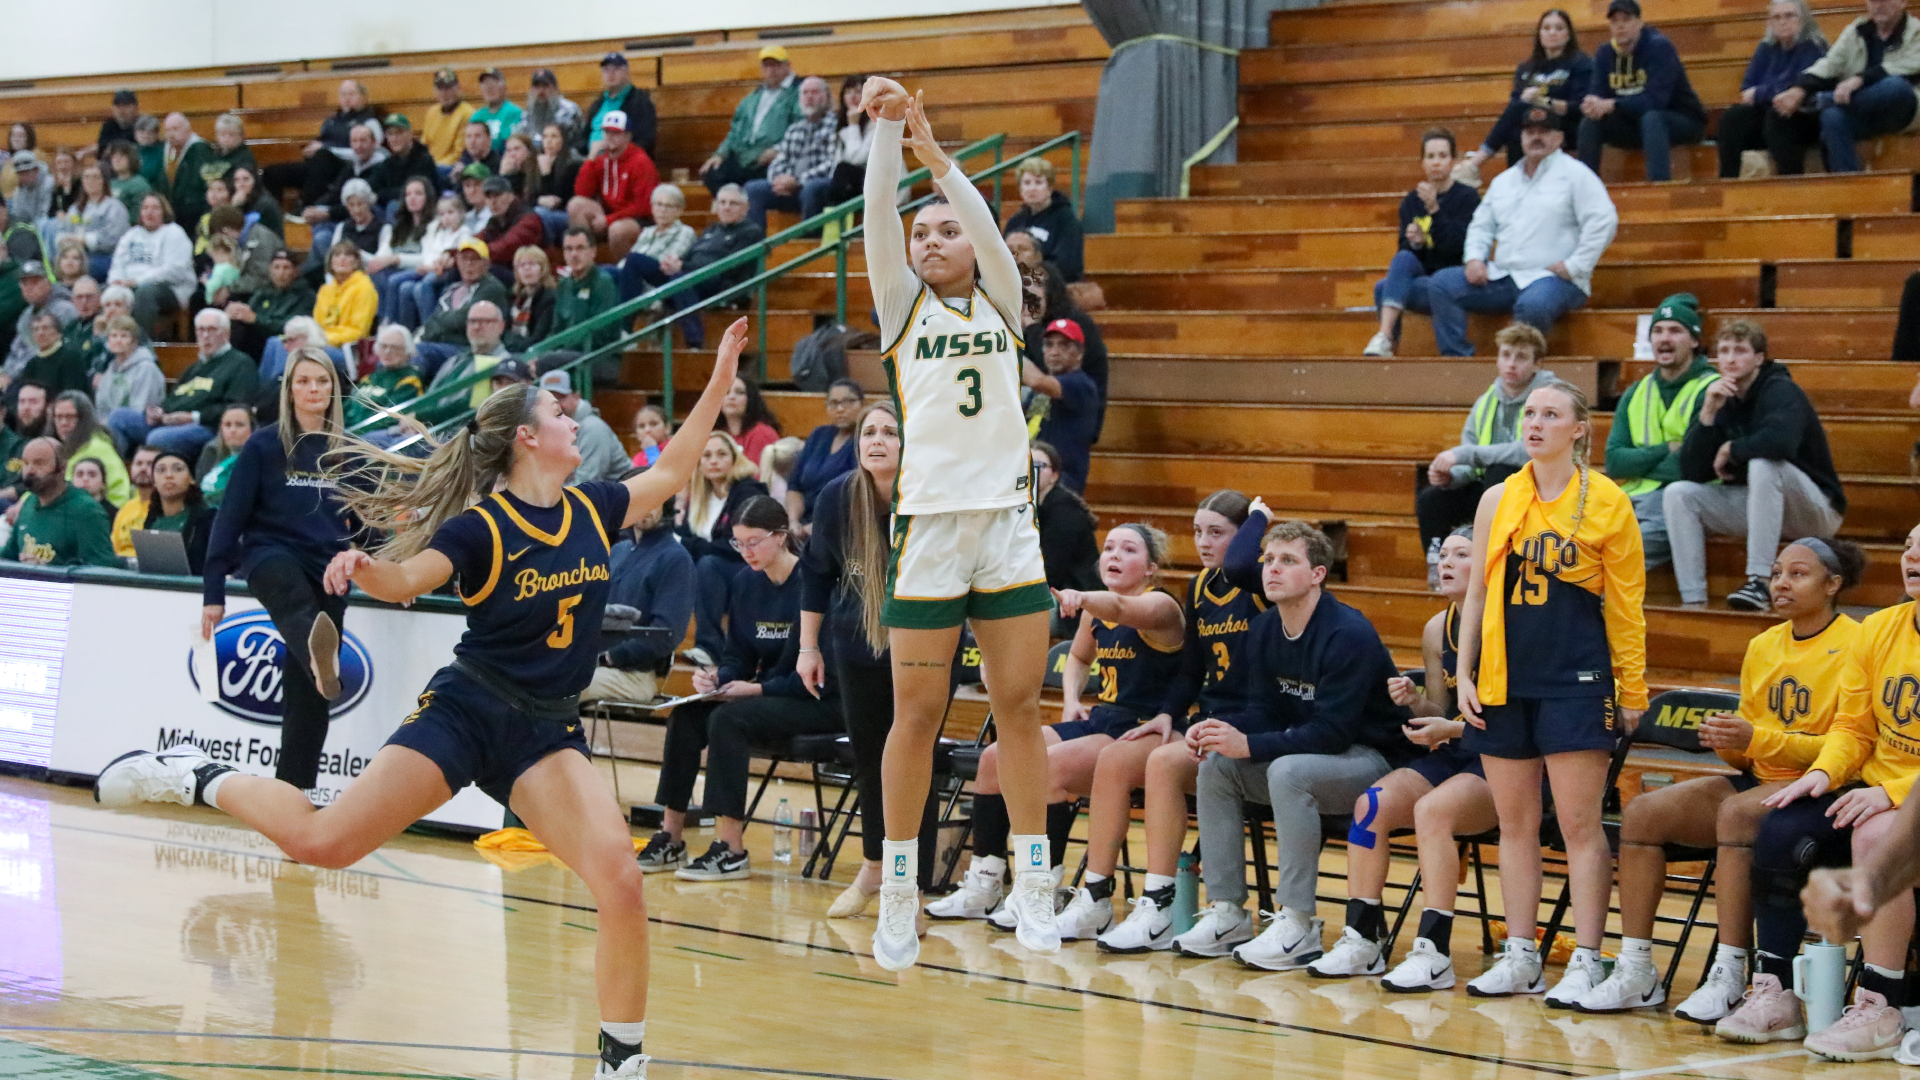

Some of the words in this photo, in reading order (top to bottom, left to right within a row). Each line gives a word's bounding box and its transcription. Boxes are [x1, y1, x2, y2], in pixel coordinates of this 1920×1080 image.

[914, 328, 1009, 361] MSSU
[954, 365, 984, 419] 3
[1521, 529, 1579, 577] UCO
[513, 557, 610, 602] Bronchos
[546, 593, 583, 649] 5
[1767, 674, 1813, 729] UCO
